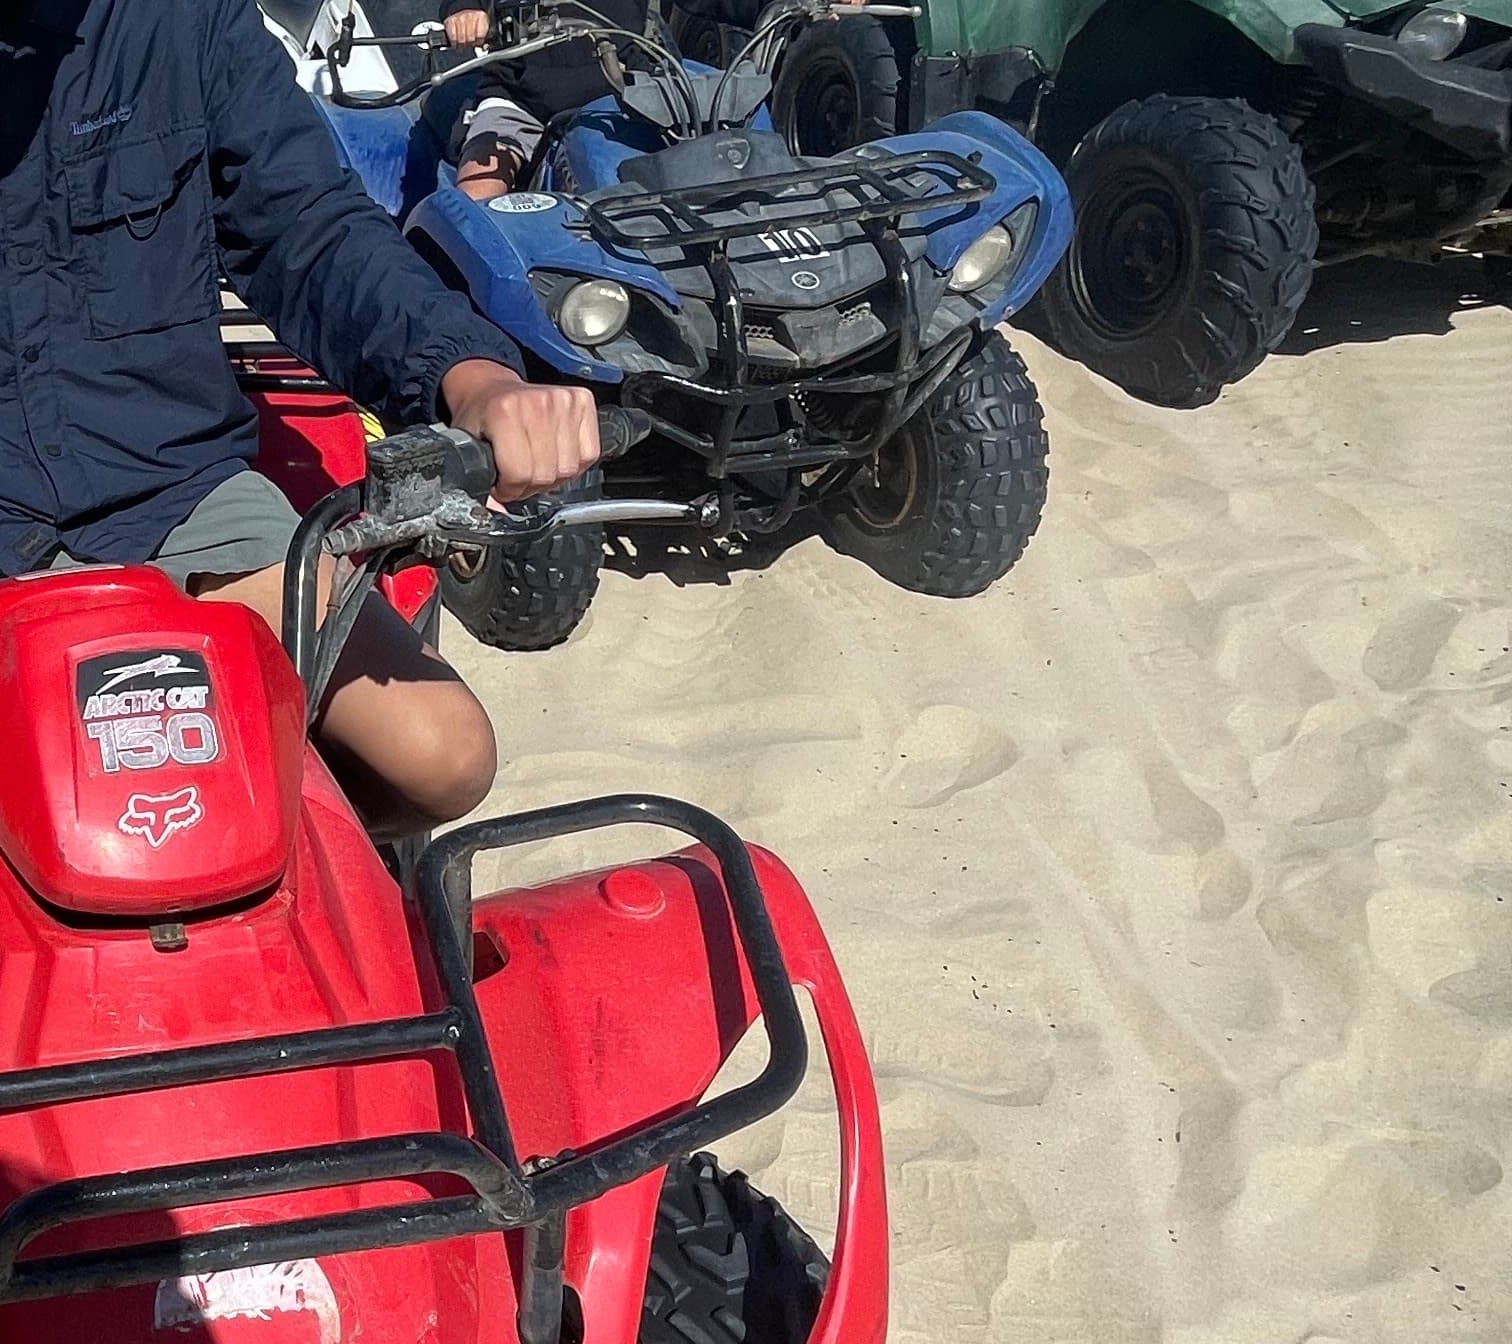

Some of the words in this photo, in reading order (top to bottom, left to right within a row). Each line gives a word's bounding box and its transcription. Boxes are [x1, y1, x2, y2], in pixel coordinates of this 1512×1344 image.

[82, 687, 166, 720] ARCTIC
[165, 685, 209, 710] CAT
[87, 712, 219, 773] 150
